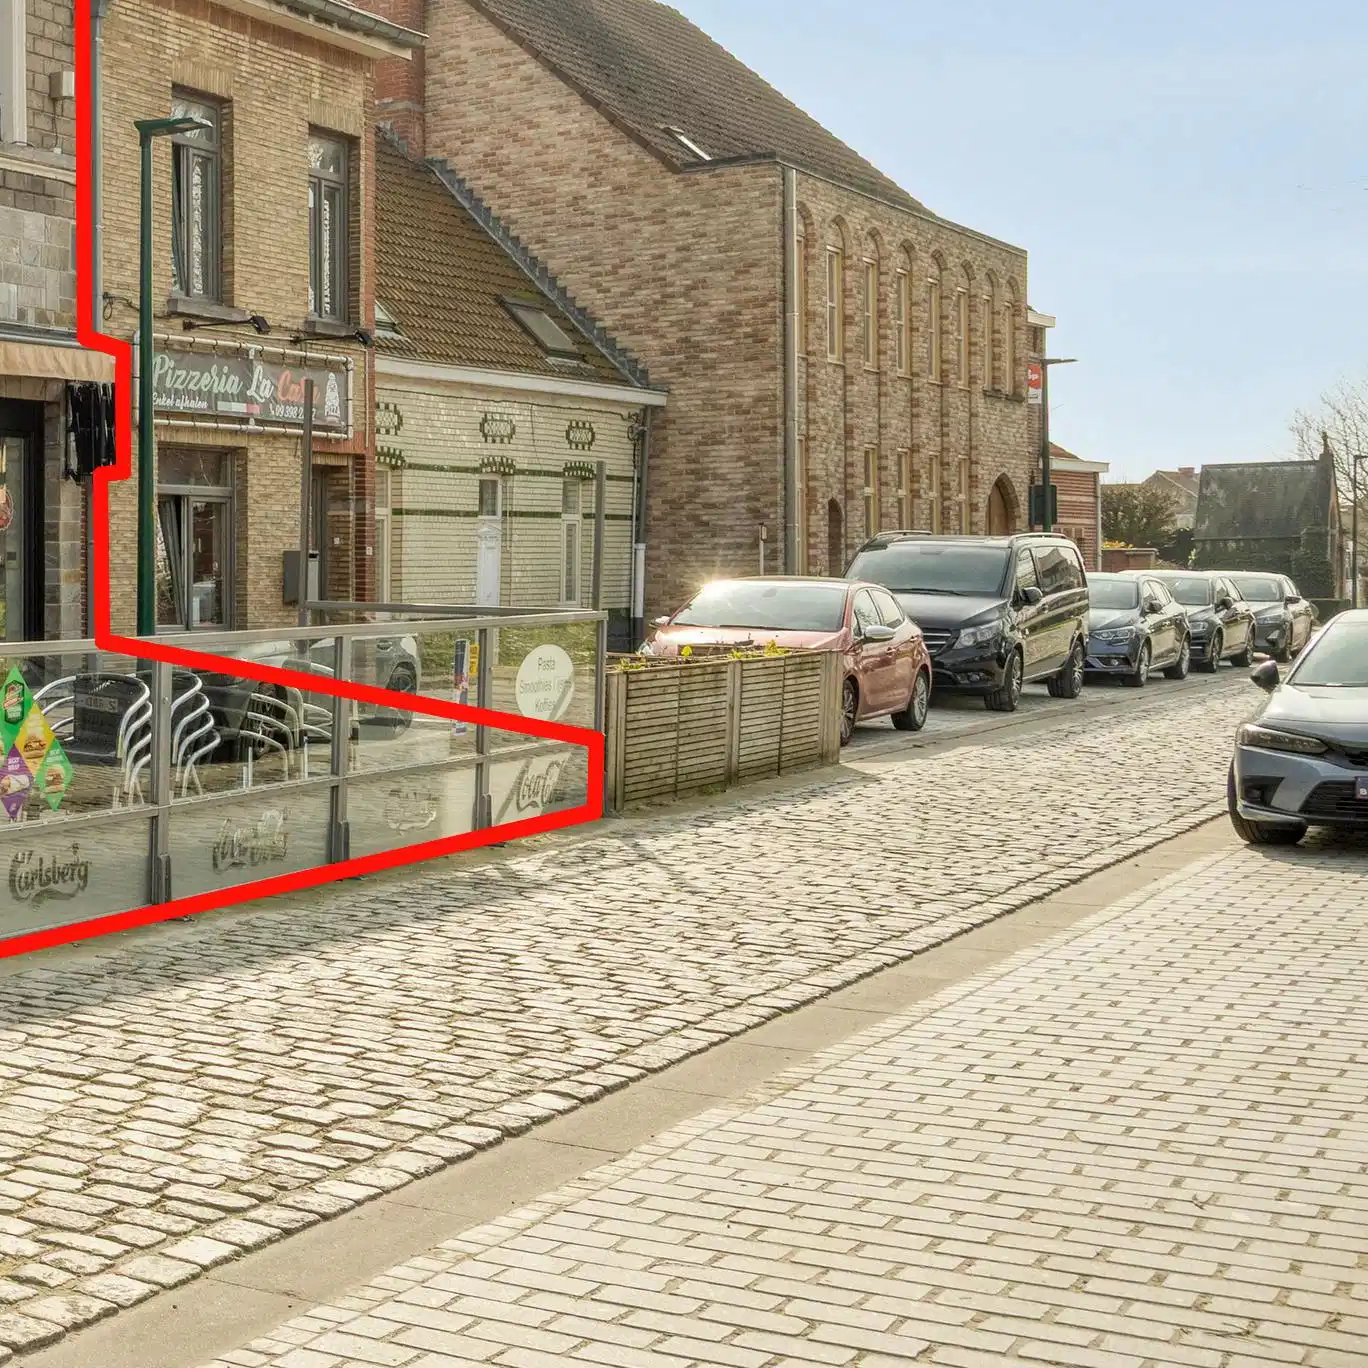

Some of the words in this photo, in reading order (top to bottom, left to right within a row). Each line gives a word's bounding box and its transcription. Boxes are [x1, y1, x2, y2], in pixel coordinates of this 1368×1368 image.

[152, 354, 243, 394] Pizzeria
[247, 365, 275, 403] La
[152, 392, 175, 407] Enkel
[176, 394, 209, 410] afhalen
